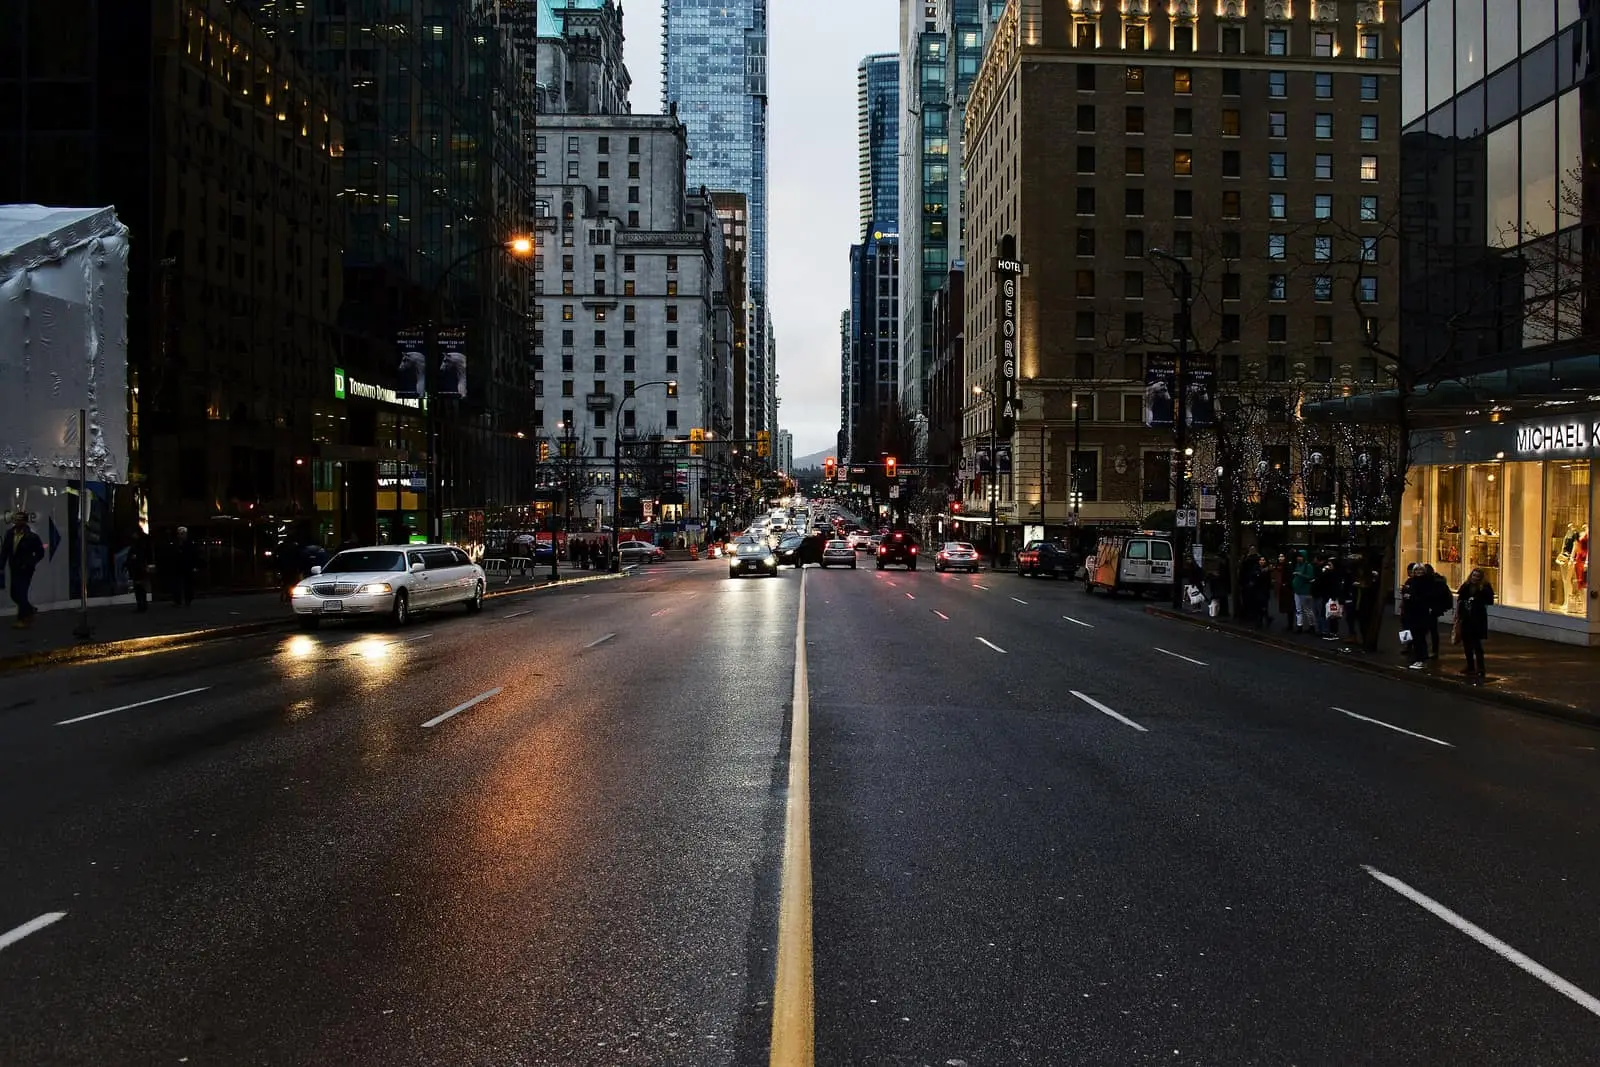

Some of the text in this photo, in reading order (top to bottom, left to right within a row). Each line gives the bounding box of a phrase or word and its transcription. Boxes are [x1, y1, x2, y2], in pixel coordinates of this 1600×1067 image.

[998, 259, 1021, 272] HOTEL
[1003, 279, 1015, 418] GEORGIA
[349, 377, 376, 399] TORONTO
[1515, 423, 1583, 450] MICHAEL
